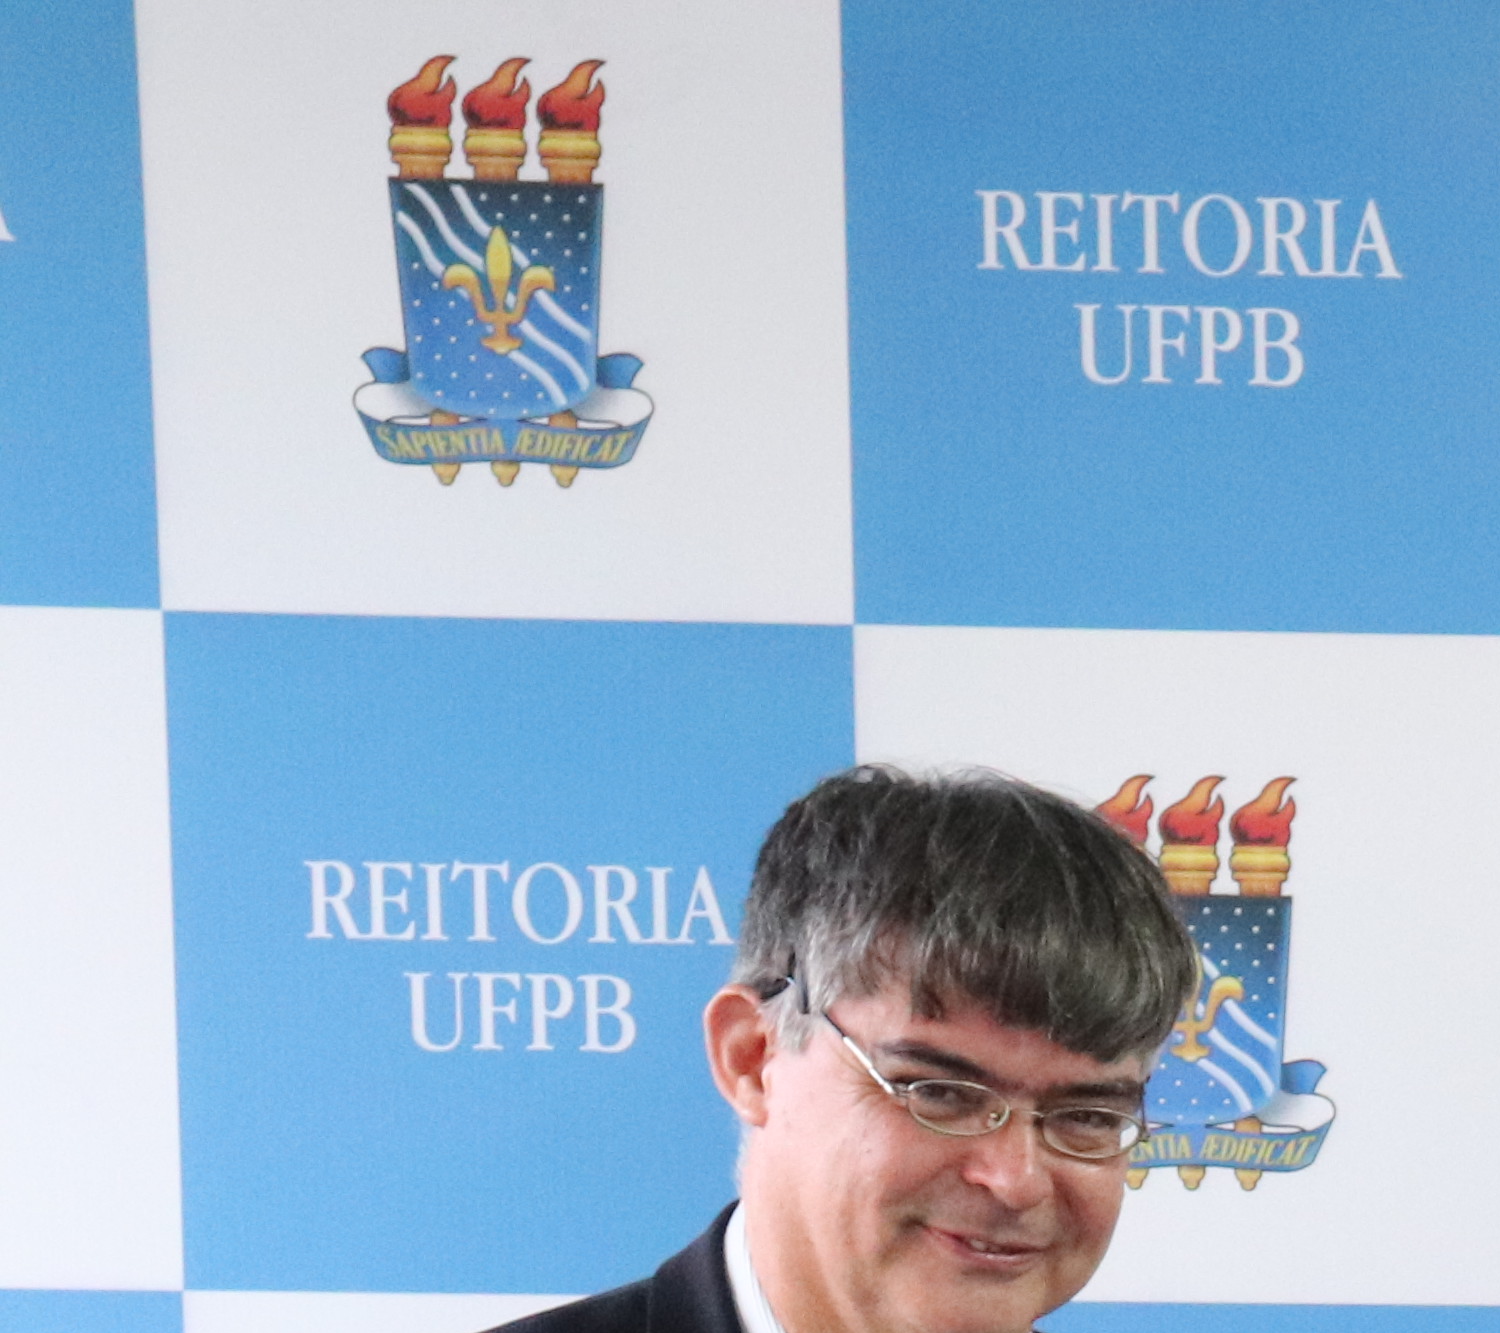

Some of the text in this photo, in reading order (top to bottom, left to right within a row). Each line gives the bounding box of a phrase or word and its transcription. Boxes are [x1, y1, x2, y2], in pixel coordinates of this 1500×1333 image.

[976, 191, 1402, 278] REITORIA
[1075, 304, 1303, 387] UFPB
[304, 861, 734, 944] REITORIA
[405, 973, 636, 1052] UFPB
